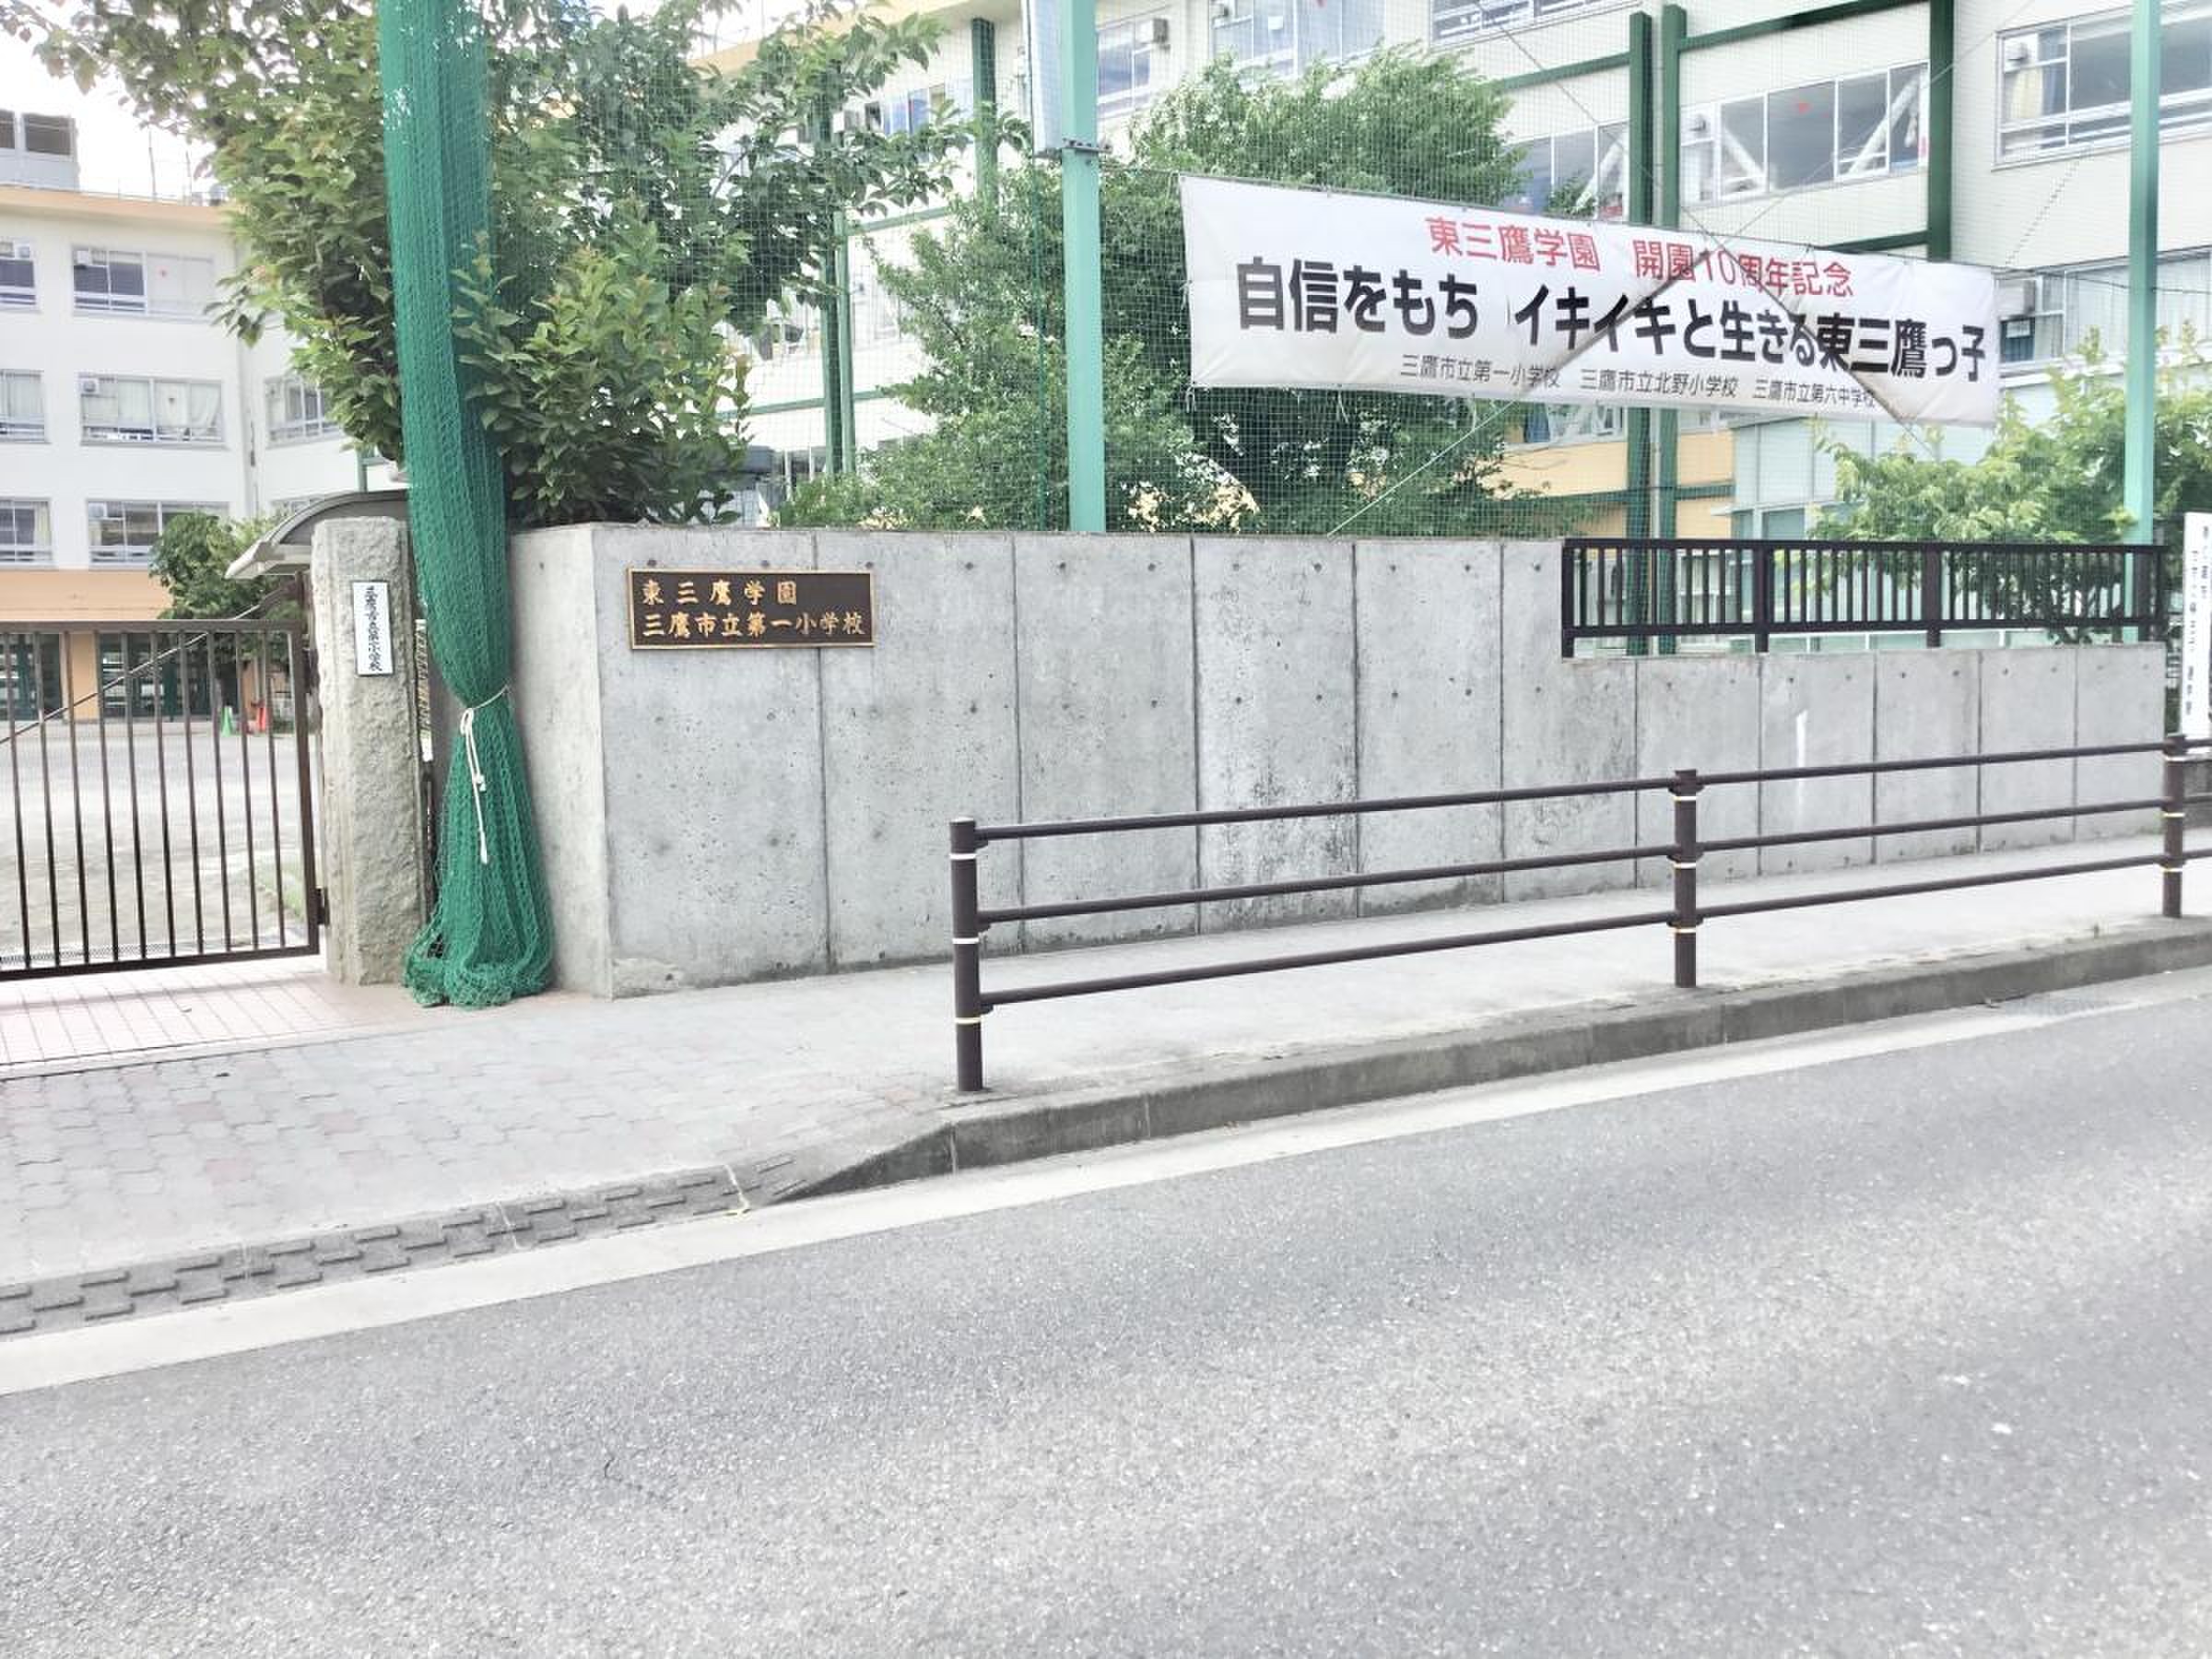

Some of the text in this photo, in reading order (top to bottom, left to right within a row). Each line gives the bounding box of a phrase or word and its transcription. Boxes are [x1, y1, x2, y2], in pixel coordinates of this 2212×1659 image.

[1425, 216, 1854, 298] 東三鷹学園 開園10周年記念
[1237, 255, 1986, 382] 自信をもち イキイキと生きる東三鷹っ子
[1400, 353, 1561, 389] 三鷹市立第一小学校
[1580, 369, 1740, 399] 三鷹市立北野小学校
[642, 578, 797, 606] 東三鷹学園
[642, 611, 865, 638] 三鷹市立第一小学校
